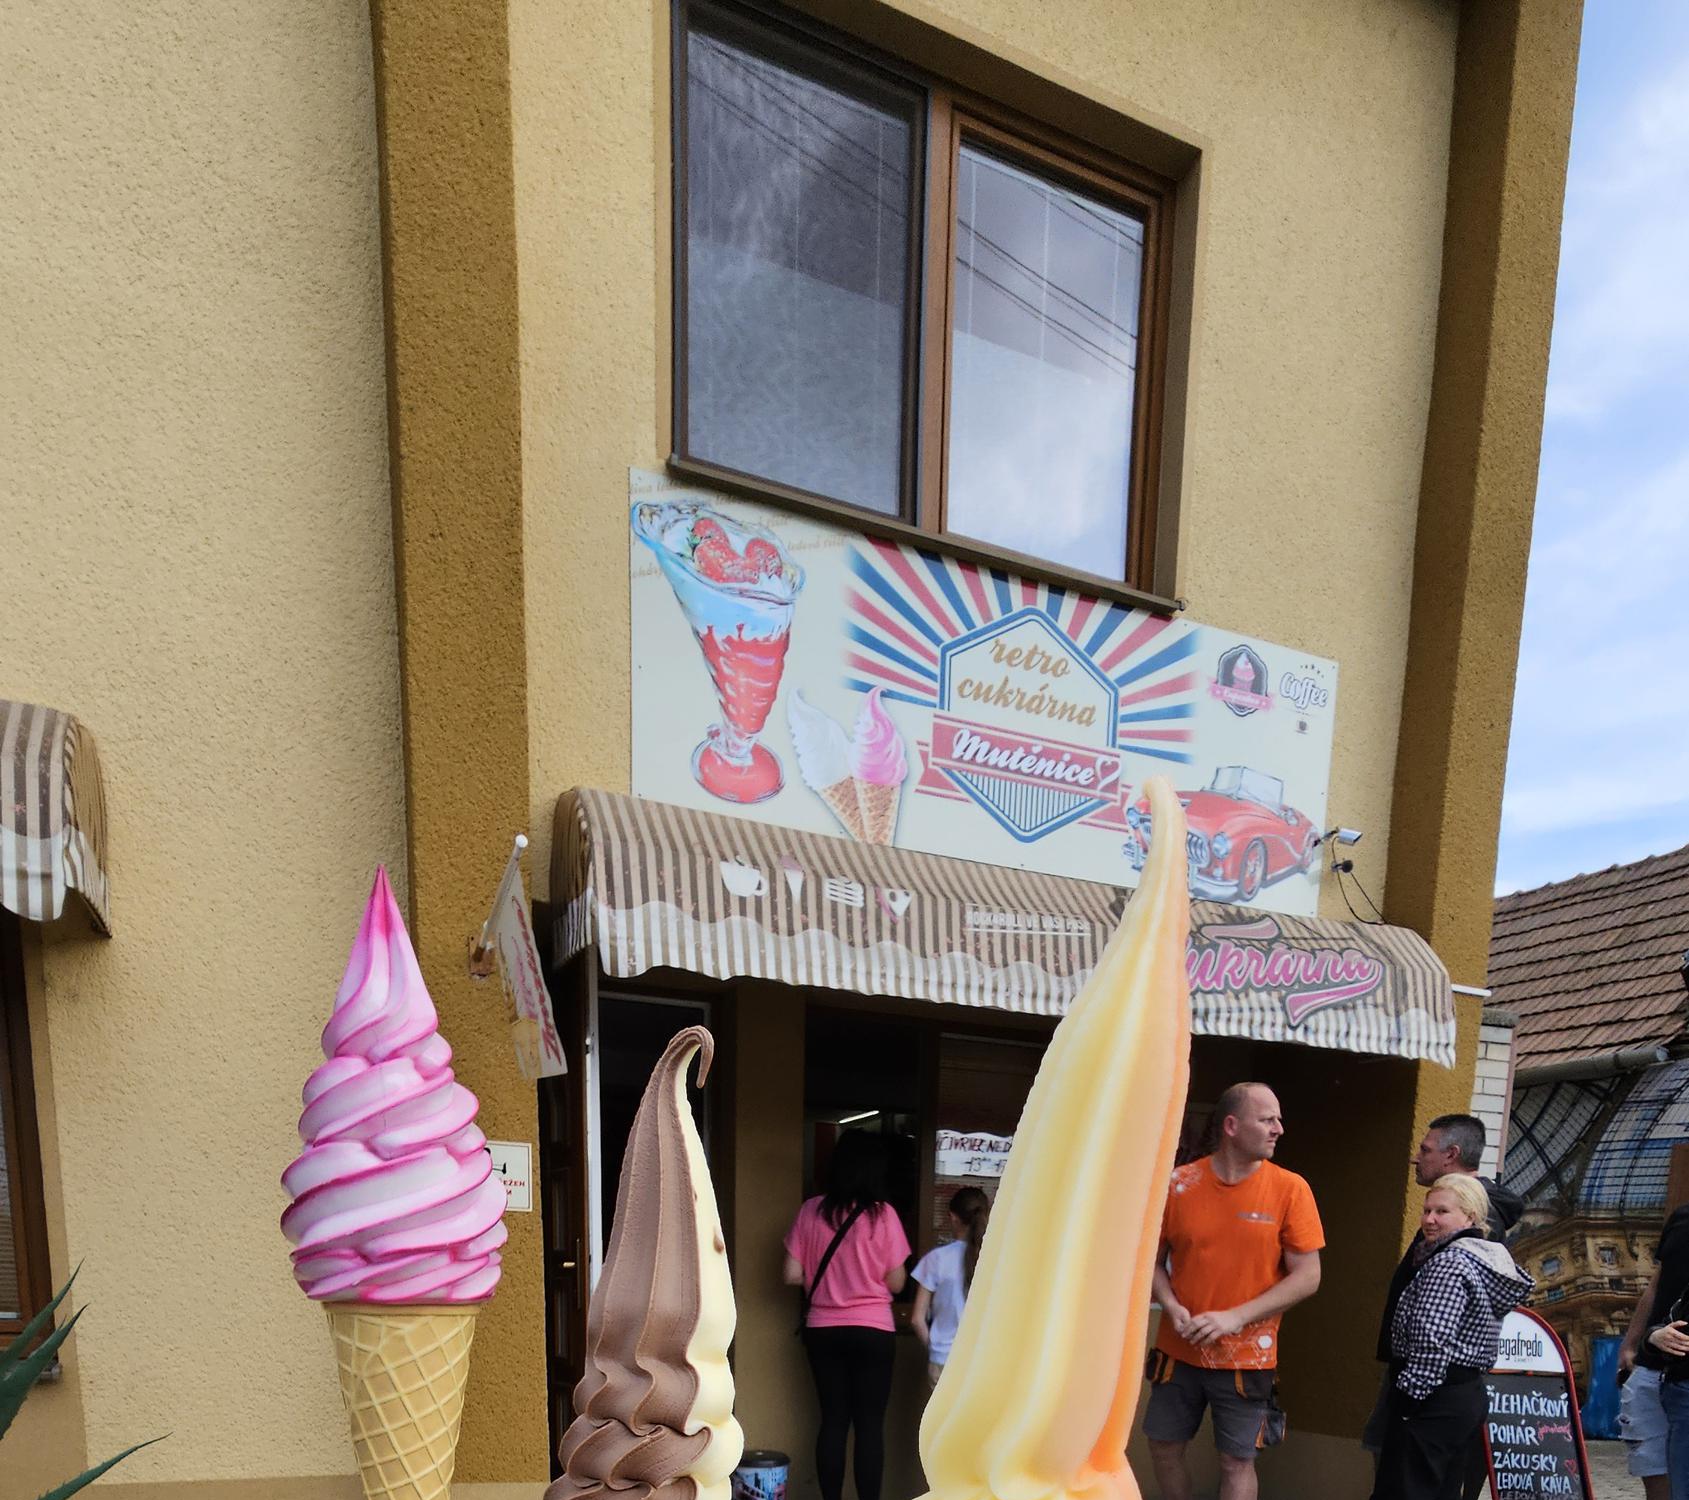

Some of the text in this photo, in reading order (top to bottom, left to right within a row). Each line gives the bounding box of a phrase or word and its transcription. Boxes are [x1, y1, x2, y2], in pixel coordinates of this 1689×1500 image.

[990, 639, 1070, 678] retro
[957, 675, 1097, 727] cukrárna
[1280, 672, 1328, 709] Coffee
[952, 729, 1096, 785] Mutěnice
[1186, 932, 1382, 1000] ukrárna
[1499, 1331, 1543, 1360] egafredo
[1488, 1419, 1540, 1446] POHÁR
[1493, 1448, 1558, 1473] ZÁKUSKY
[1497, 1472, 1573, 1495] LEDOVÁ KÁVA
